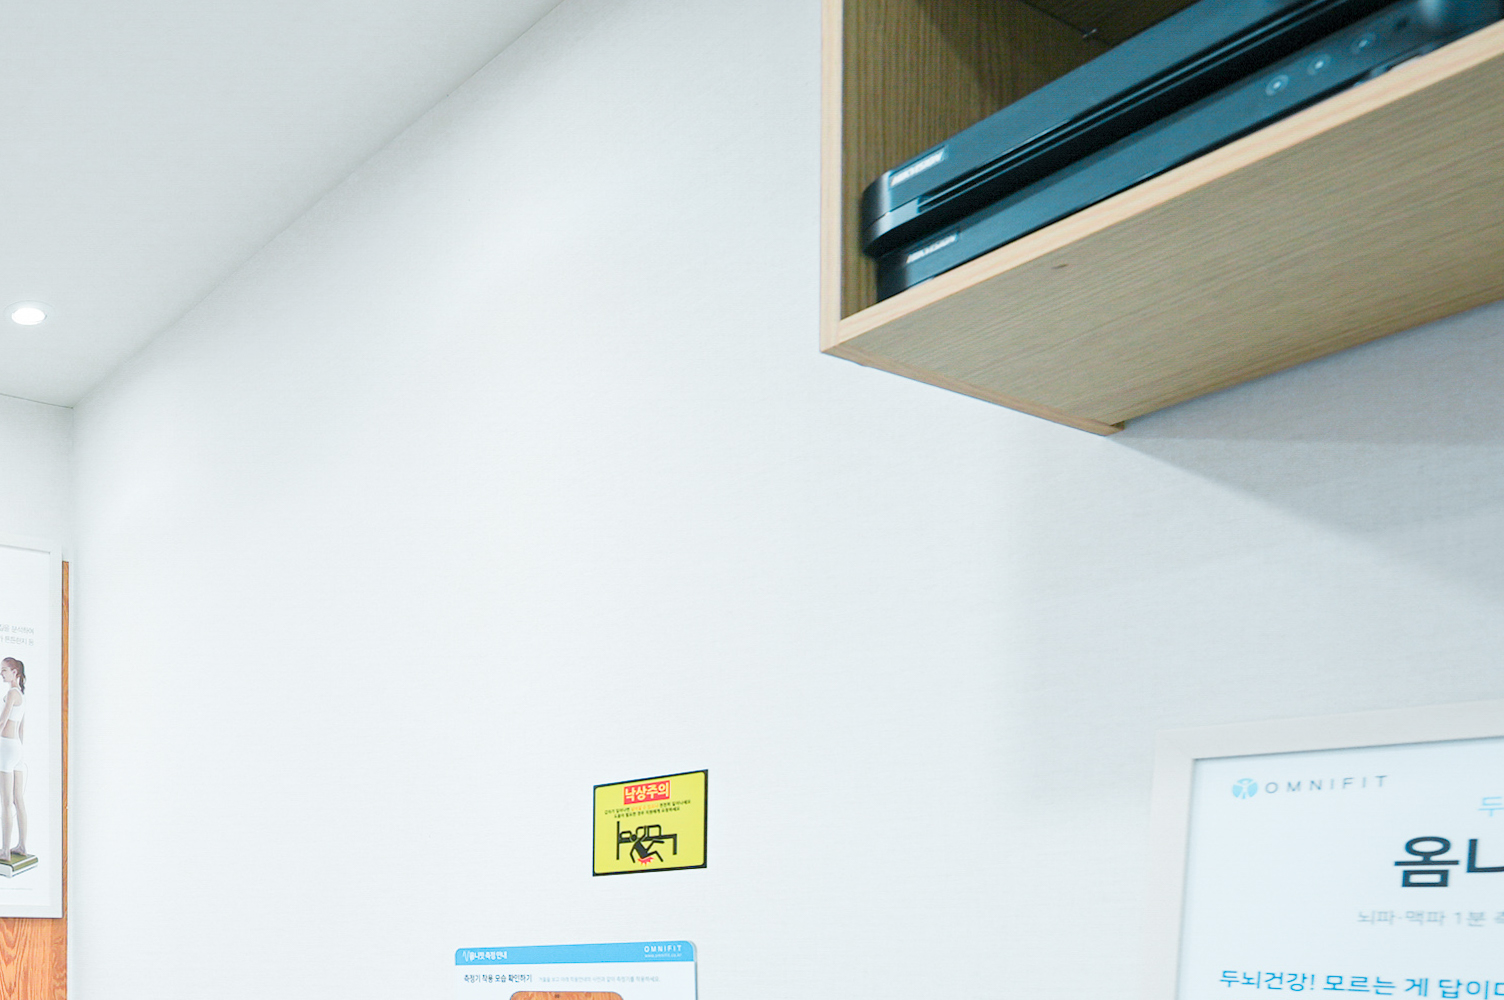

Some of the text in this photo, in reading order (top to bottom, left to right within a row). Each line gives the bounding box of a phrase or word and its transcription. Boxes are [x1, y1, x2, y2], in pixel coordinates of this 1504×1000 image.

[625, 782, 669, 802] 낙상주의
[1265, 775, 1388, 794] OMNIFIT
[644, 945, 682, 953] OMNIFIT
[1219, 970, 1504, 1000] 두뇌건강! 모르는 게 답이
